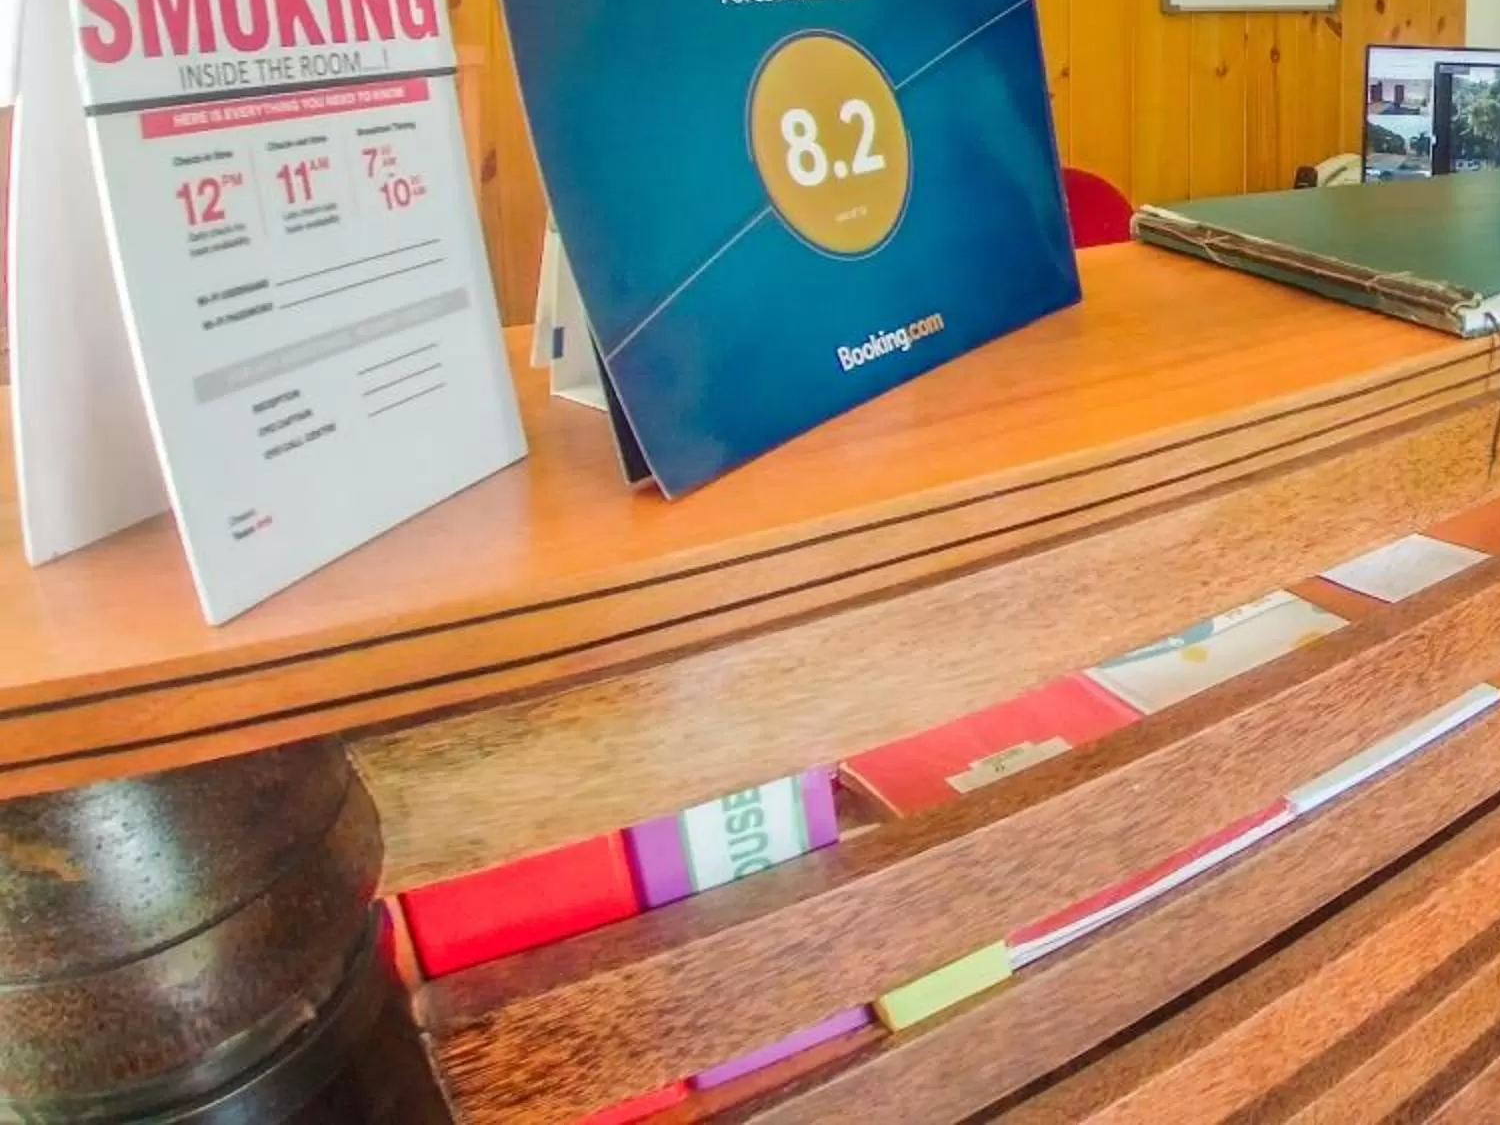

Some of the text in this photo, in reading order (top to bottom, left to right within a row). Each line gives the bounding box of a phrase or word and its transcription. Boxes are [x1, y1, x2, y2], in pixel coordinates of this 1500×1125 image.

[179, 61, 250, 91] INSIDE
[253, 56, 296, 84] THE
[223, 98, 300, 121] EVERYTHING
[301, 95, 325, 111] YOU
[780, 98, 886, 186] 8.2
[361, 147, 378, 178] 7
[176, 177, 225, 226] 12
[277, 162, 312, 204] 11
[380, 178, 411, 210] 10
[837, 312, 945, 371] Booking.com
